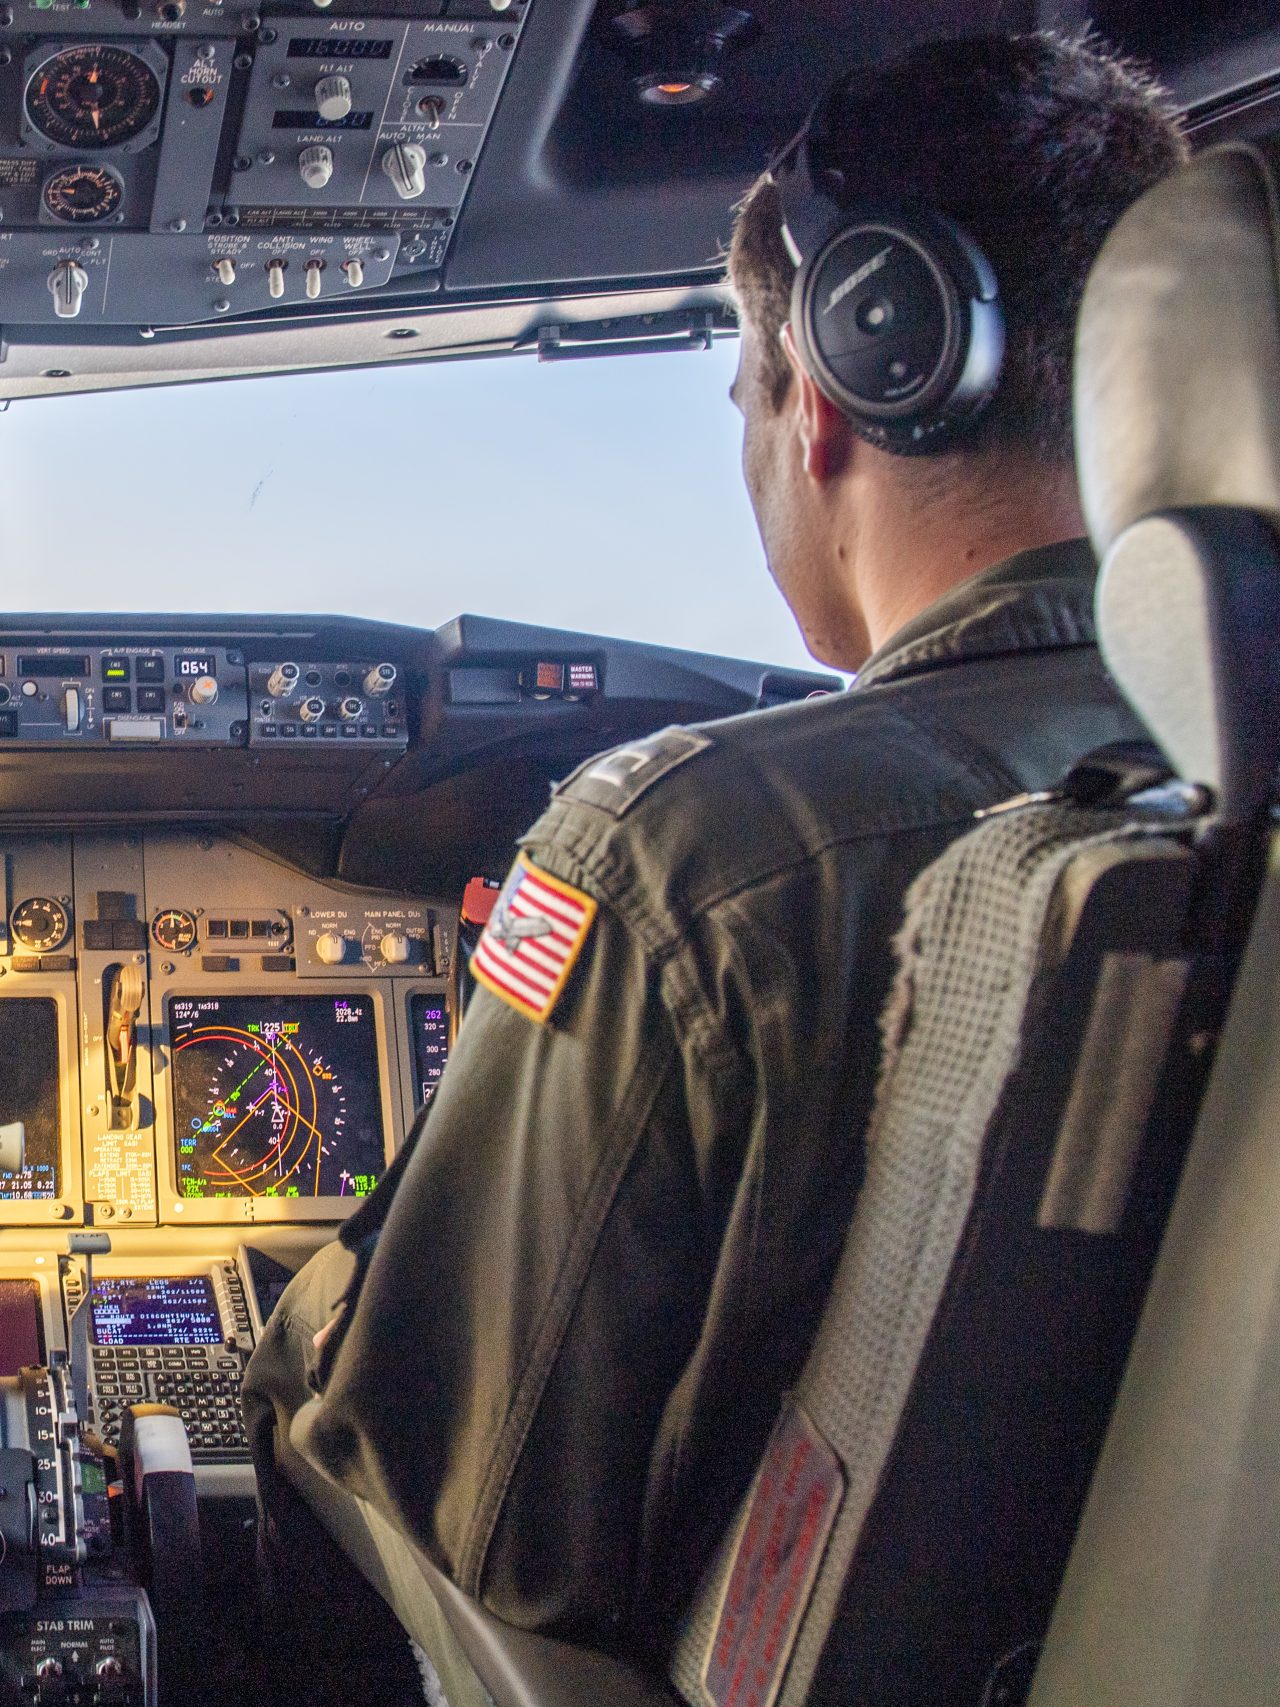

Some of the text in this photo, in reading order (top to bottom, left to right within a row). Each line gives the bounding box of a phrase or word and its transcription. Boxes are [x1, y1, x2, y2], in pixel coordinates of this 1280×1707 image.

[202, 8, 225, 16] AUTO
[329, 22, 366, 31] AUTO
[423, 23, 476, 33] MANUAL
[192, 59, 216, 67] ALT
[189, 67, 218, 76] HORN
[319, 64, 355, 73] FLT ALT
[180, 75, 223, 84] CUTOUT
[379, 132, 406, 140] AUTO
[207, 235, 251, 243] POSITION
[181, 661, 209, 674] 064
[425, 1010, 442, 1019] 262
[247, 1024, 260, 1032] TRK
[263, 1023, 281, 1032] 225
[180, 1146, 194, 1154] 000
[11, 1181, 33, 1189] 21.05
[37, 1181, 54, 1189] 8.22
[35, 1407, 48, 1415] 10
[37, 1431, 50, 1440] 15
[37, 1460, 51, 1470] 25
[38, 1491, 54, 1502] 30
[40, 1534, 57, 1545] 40
[46, 1565, 71, 1573] FLAP
[45, 1576, 73, 1585] DOWN
[36, 1620, 94, 1631] STAB TRIM
